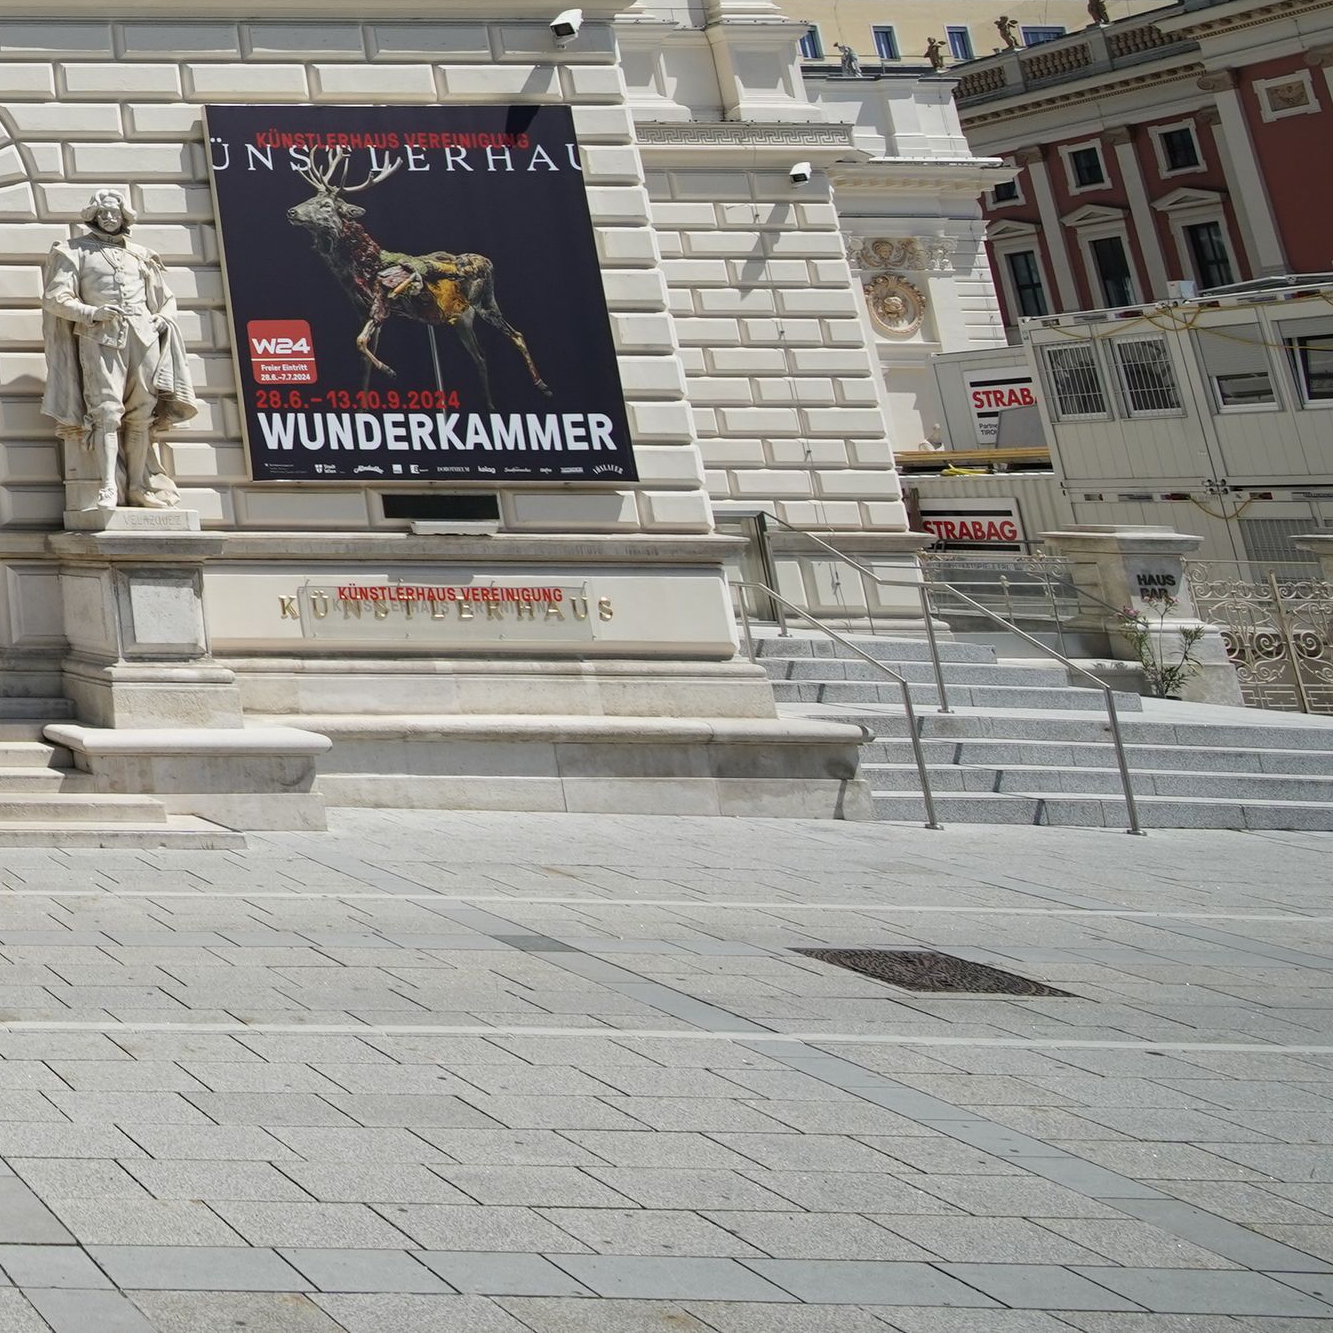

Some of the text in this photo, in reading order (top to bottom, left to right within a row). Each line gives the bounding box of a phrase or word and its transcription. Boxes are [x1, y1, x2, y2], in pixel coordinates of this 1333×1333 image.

[255, 128, 530, 150] KÜNSTLERHAUS VEREINIGUNG
[251, 337, 311, 355] W24
[261, 363, 309, 372] Freier Eintritt
[972, 387, 1037, 409] STRAB
[256, 412, 618, 451] WUNDERKAMMER
[922, 520, 1017, 541] STRABAG
[1136, 574, 1176, 586] HAUS
[338, 583, 563, 603] KÜNSTLERHAUS VEREINIGUNG
